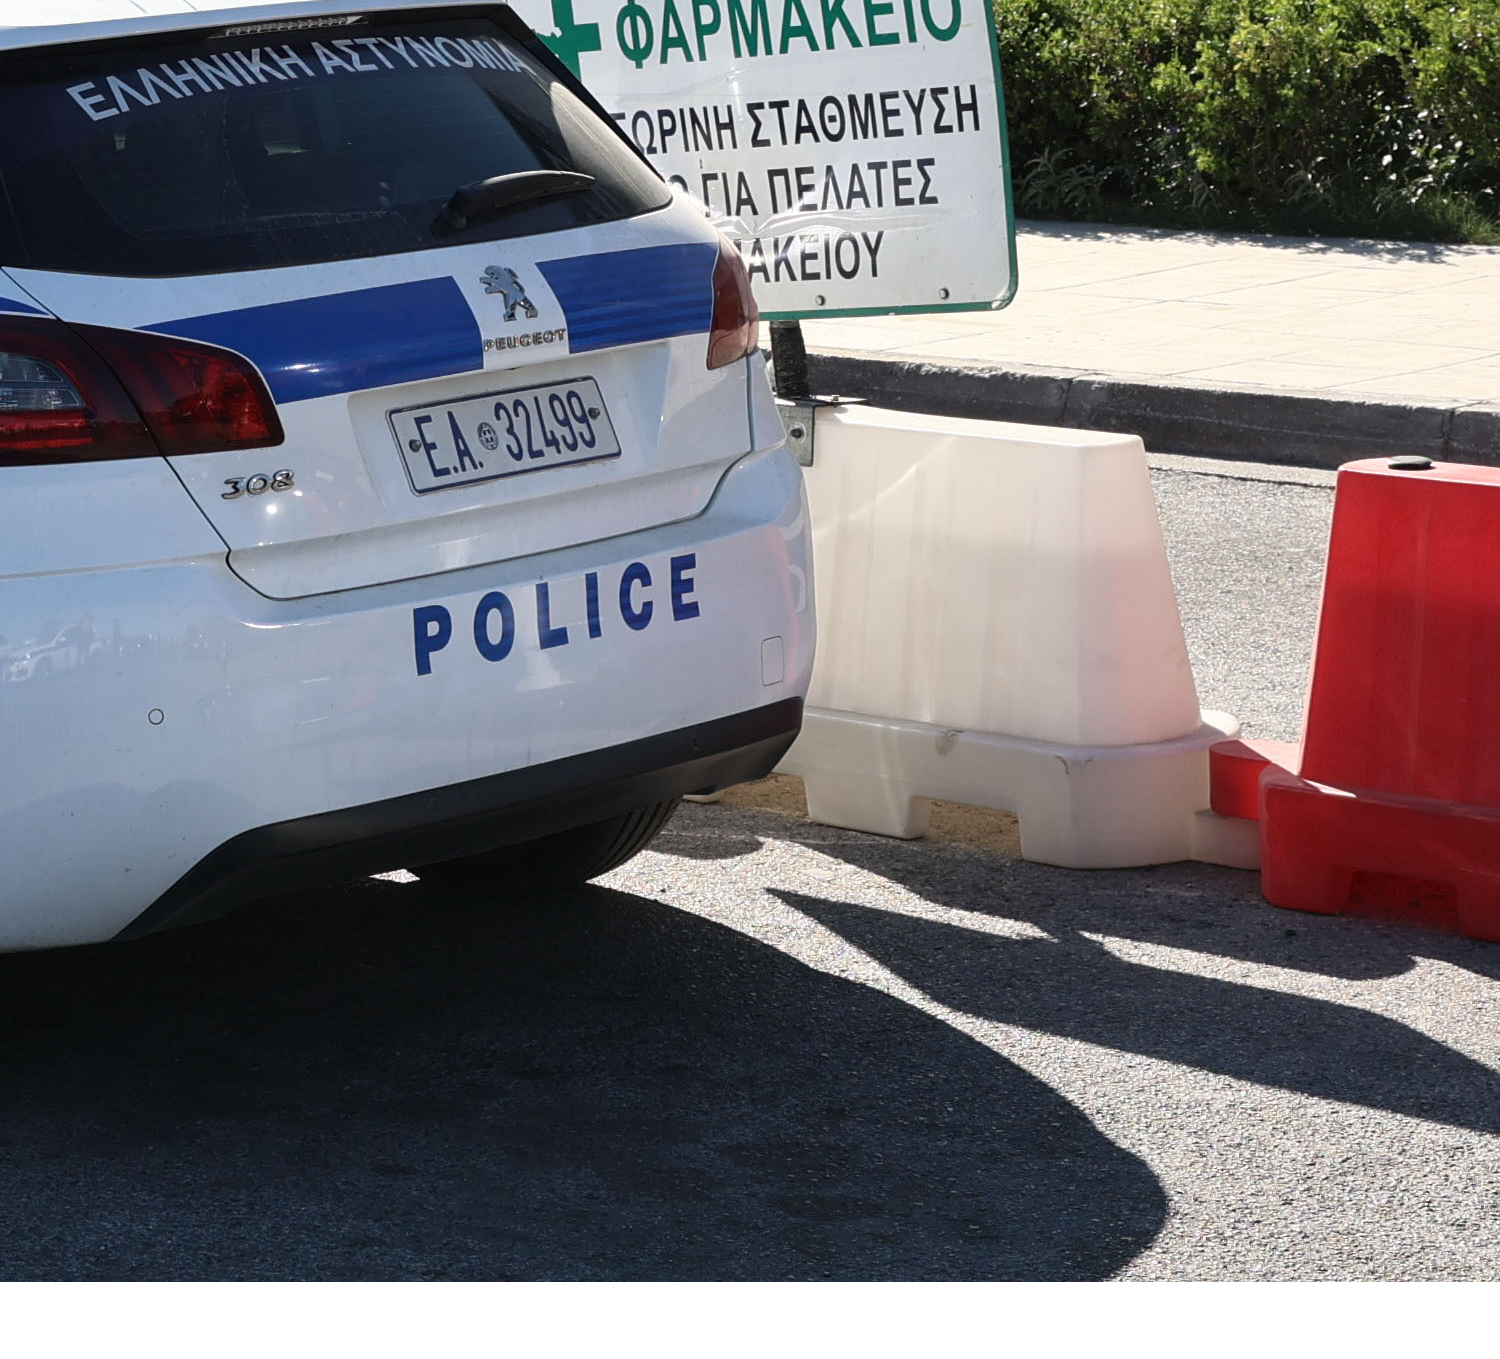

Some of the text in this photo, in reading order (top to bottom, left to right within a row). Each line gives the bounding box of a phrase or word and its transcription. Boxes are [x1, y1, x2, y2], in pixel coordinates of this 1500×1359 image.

[65, 34, 537, 122] ΕΛΛΗΝΙΚΗ ΑΣΤΥΝΟΜΙΑ
[747, 84, 980, 148] ΣΤΑΘΜΕΥΣΗ
[702, 157, 940, 218] ΓΙΑ ΠΕΛΑΤΕΣ
[734, 230, 885, 285] ΑΚΕΙΟΥ
[483, 328, 567, 352] PEUGEOT
[494, 389, 598, 462] 32499
[221, 469, 296, 500] 308
[412, 552, 703, 677] POLICE
